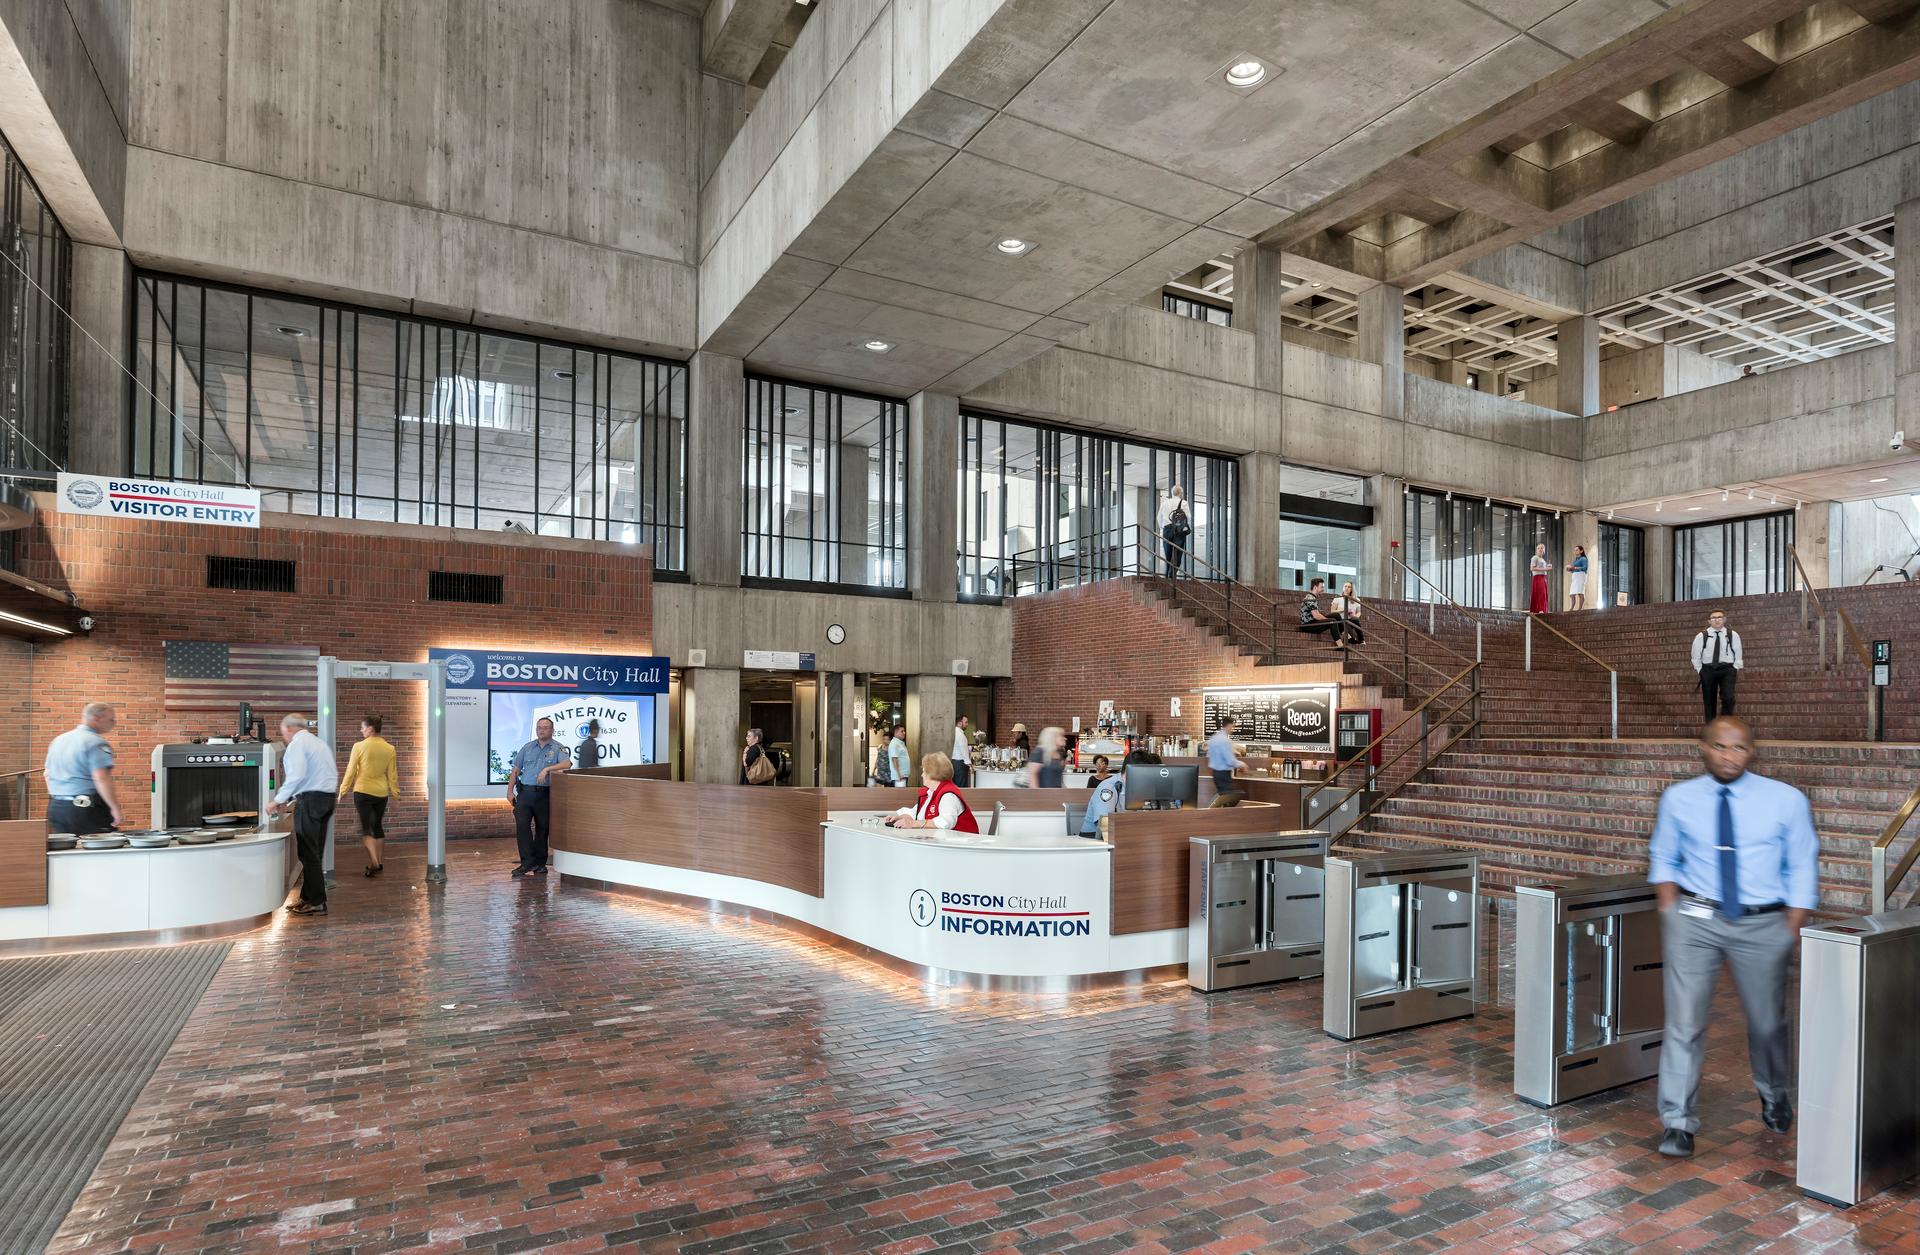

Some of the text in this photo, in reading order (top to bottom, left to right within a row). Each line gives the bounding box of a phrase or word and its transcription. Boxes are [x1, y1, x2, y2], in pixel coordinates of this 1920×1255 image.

[109, 481, 170, 496] BOSTON
[173, 487, 200, 500] City
[200, 489, 225, 501] Hall
[109, 500, 256, 523] VISITOR ENTRY
[487, 653, 517, 661] welcome
[487, 662, 579, 681] BOSTON
[582, 666, 619, 686] City
[625, 667, 661, 684] Hall
[547, 707, 627, 722] NTERING
[1287, 708, 1322, 727] Recreo
[600, 727, 618, 735] 1630
[941, 891, 1067, 912] BOSTON City Hall
[941, 915, 1090, 938] INFORMATION
